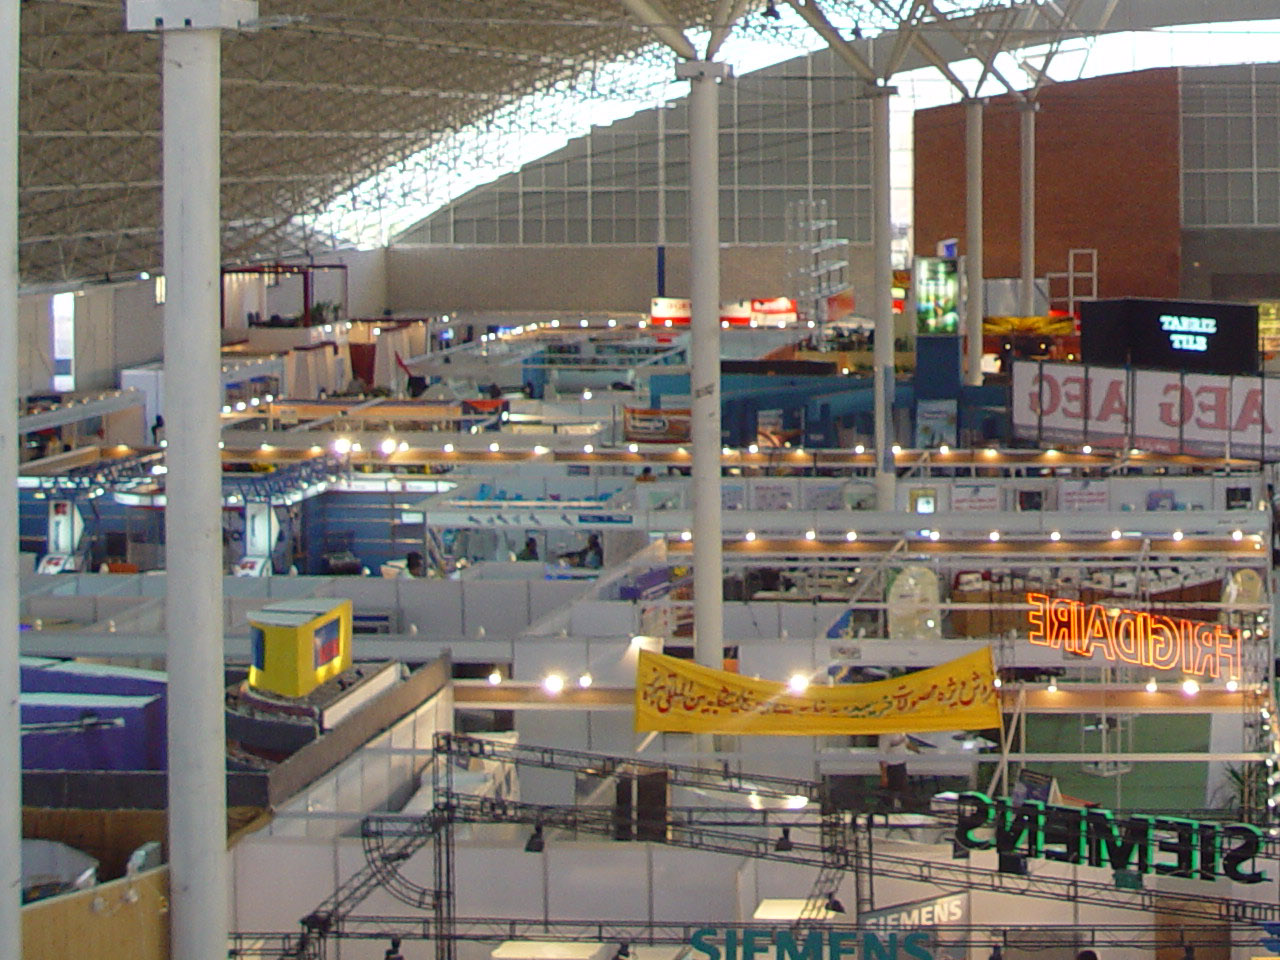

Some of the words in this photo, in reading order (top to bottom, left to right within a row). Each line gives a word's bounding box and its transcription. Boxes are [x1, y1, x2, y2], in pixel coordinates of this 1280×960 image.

[1159, 315, 1217, 334] TABRIZ
[865, 899, 962, 935] SIEMENS
[690, 927, 933, 960] SIEMENS
